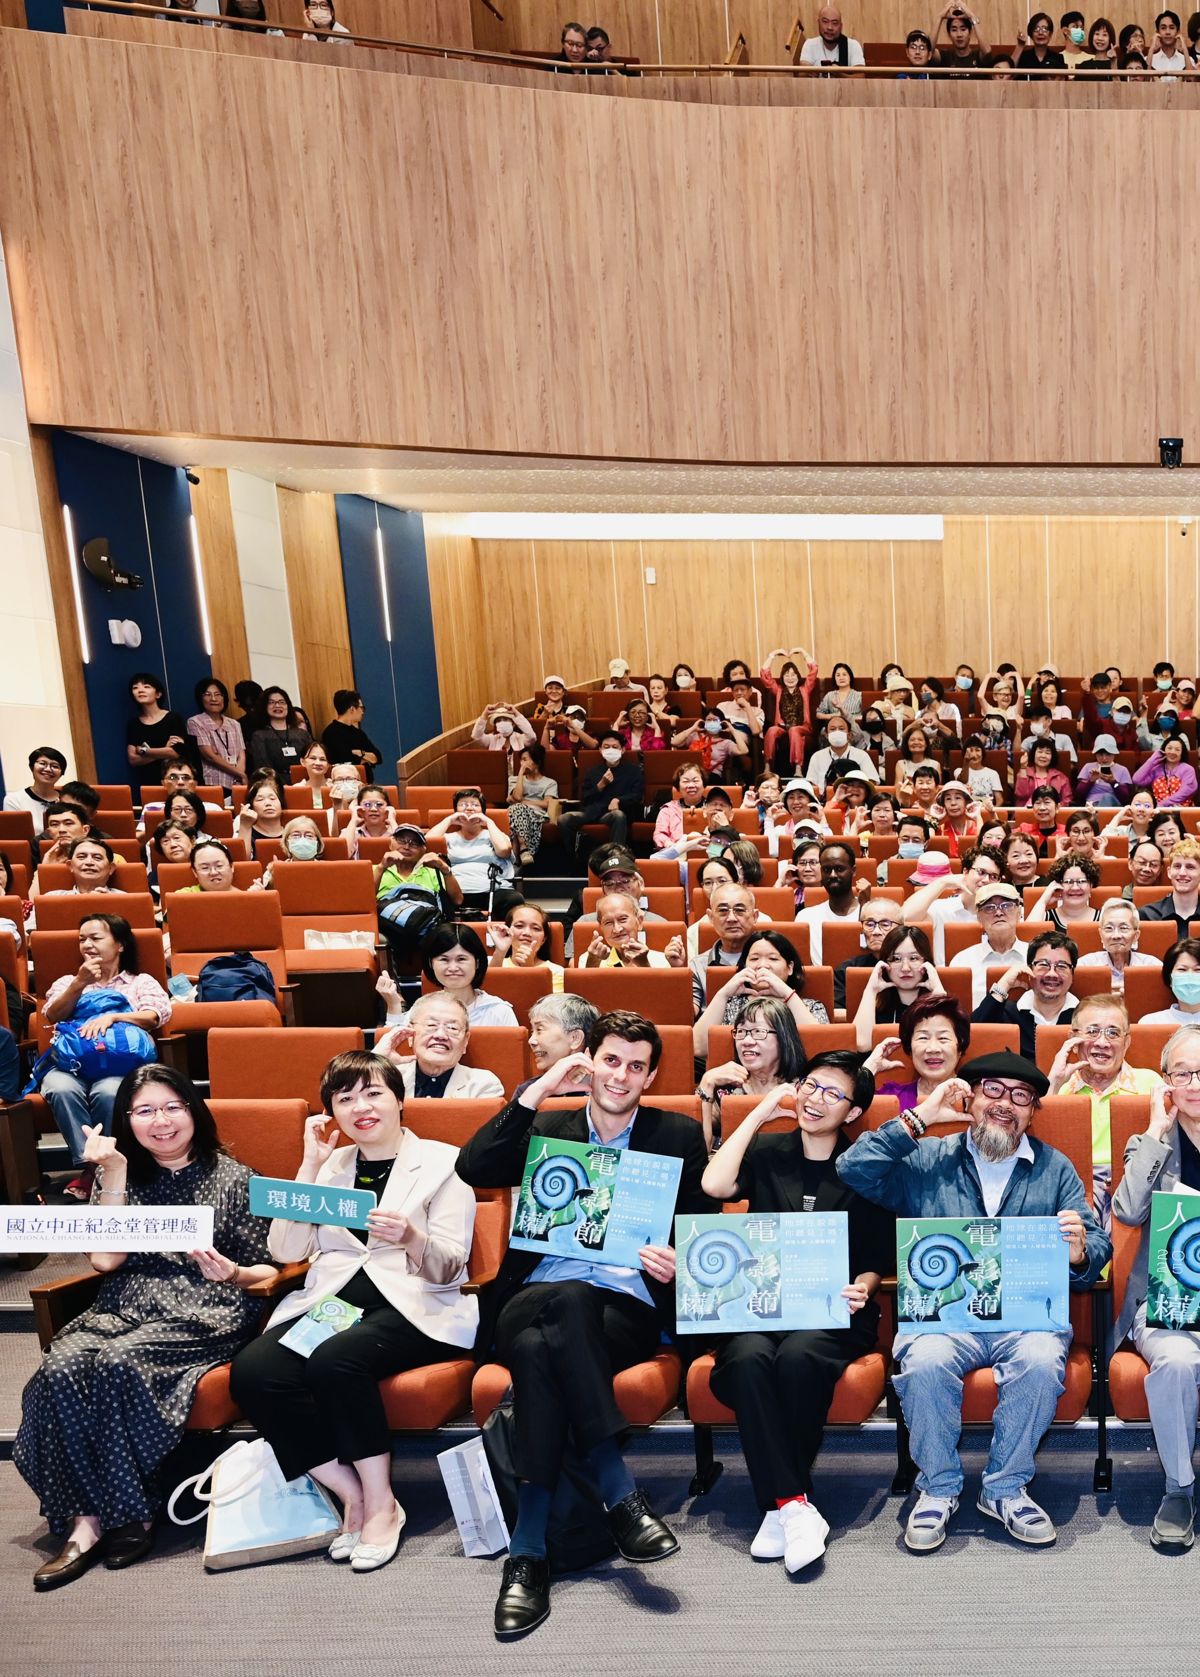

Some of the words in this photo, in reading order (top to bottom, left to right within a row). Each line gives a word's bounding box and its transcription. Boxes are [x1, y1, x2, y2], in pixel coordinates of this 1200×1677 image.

[267, 1190, 358, 1218] 環境人權
[6, 1217, 198, 1234] 國立中正紀念堂管理處
